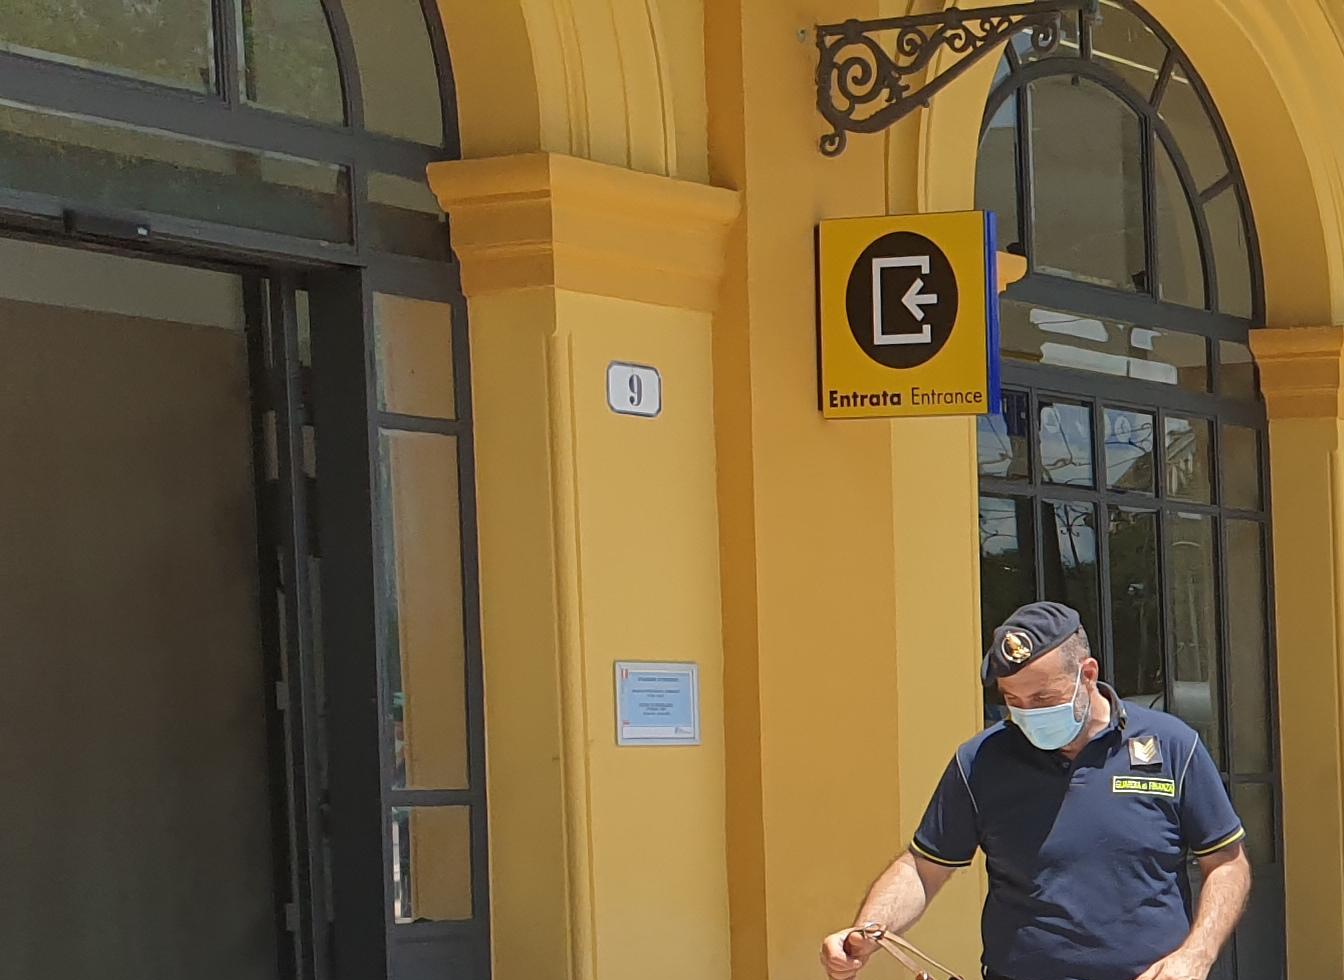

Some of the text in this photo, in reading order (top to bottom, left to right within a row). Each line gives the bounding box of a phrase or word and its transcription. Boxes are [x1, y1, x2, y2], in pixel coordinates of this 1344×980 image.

[628, 373, 643, 407] 9
[828, 387, 983, 408] Entrata Entrance
